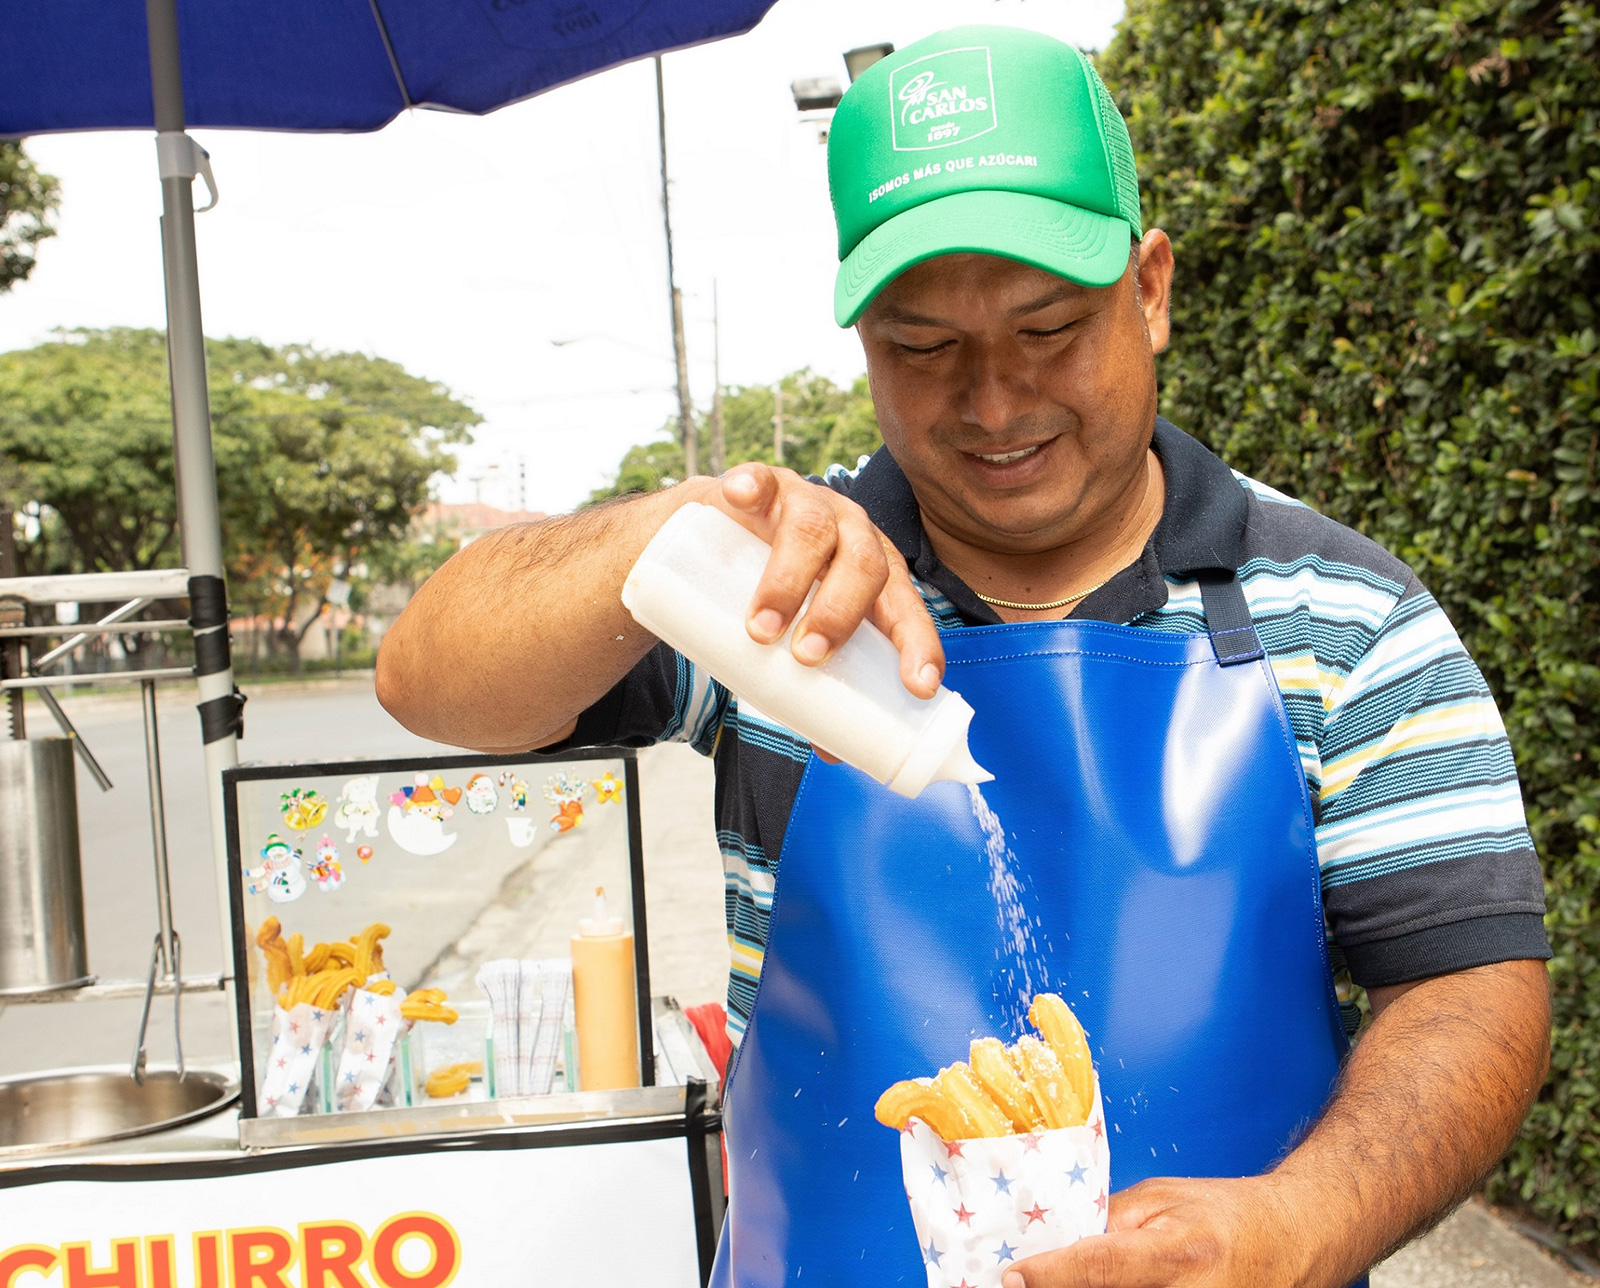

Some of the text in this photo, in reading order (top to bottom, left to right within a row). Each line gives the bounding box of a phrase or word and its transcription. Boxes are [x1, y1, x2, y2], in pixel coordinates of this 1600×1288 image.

[926, 85, 967, 106] SAN
[909, 96, 988, 125] CARLOS
[927, 126, 960, 142] 1897
[868, 152, 1038, 204] ¡SOMOS MÁS QUE AZÚCAR!
[0, 1210, 462, 1288] CHURRO
